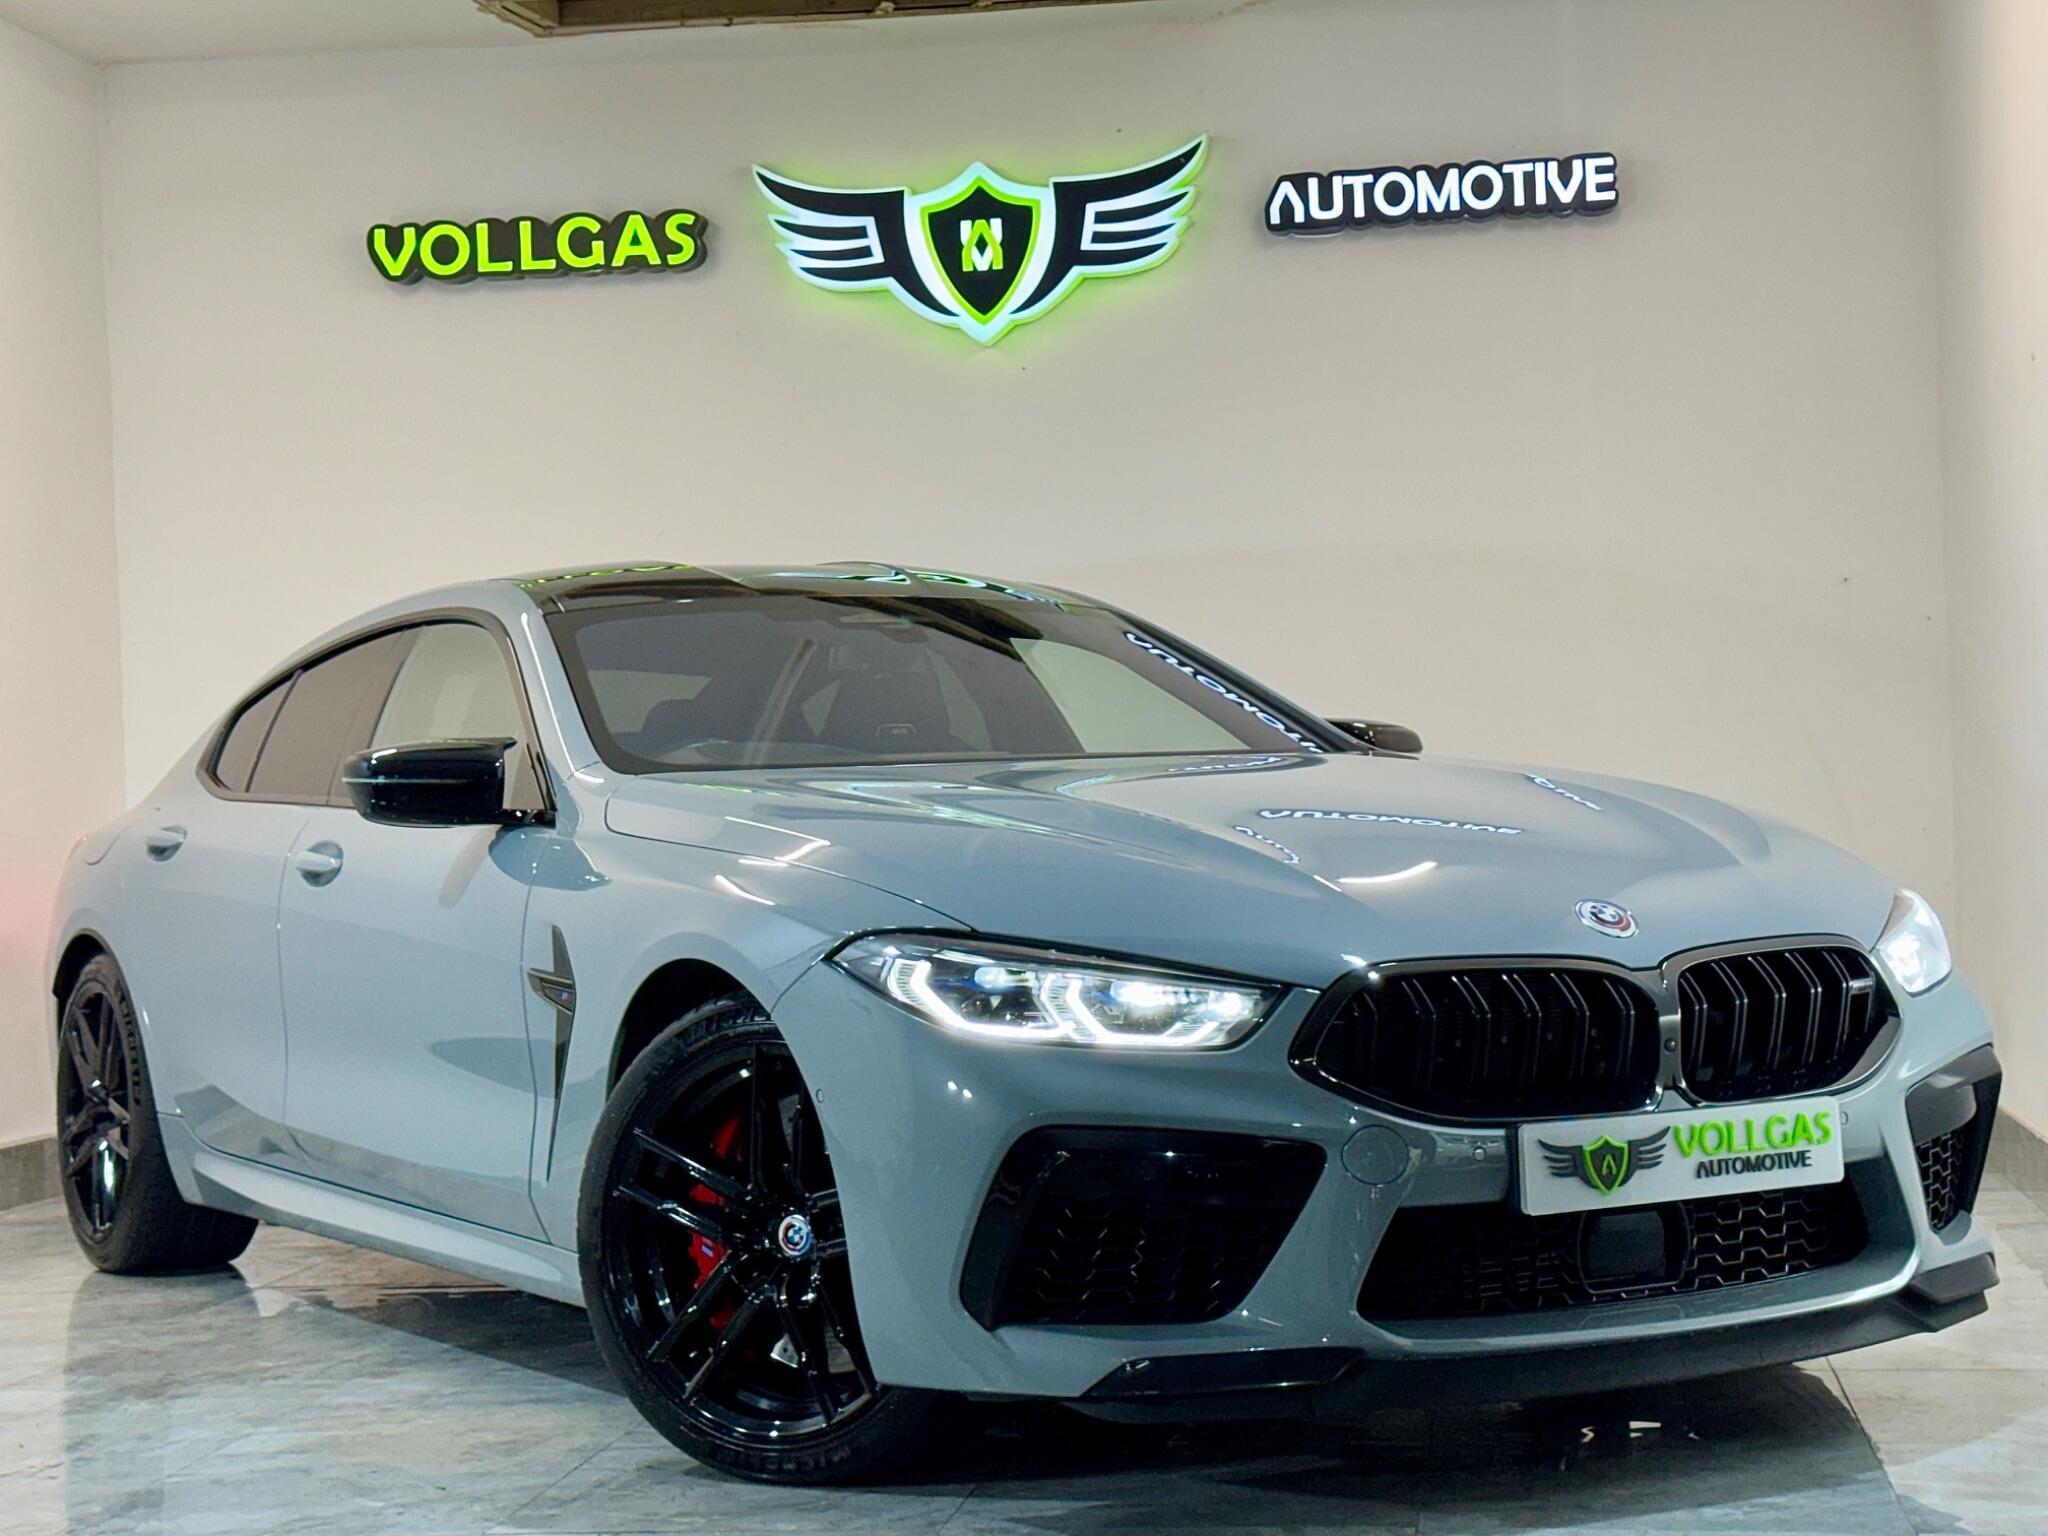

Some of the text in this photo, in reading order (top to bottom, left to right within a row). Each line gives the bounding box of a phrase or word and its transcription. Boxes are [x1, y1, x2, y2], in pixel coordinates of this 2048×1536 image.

[1269, 156, 1617, 225] AUTOMOTIVE
[372, 212, 697, 278] VOLLGAS
[1673, 1111, 1833, 1158] VOLLGAS
[1696, 1149, 1813, 1179] AUTOMOTIVE
